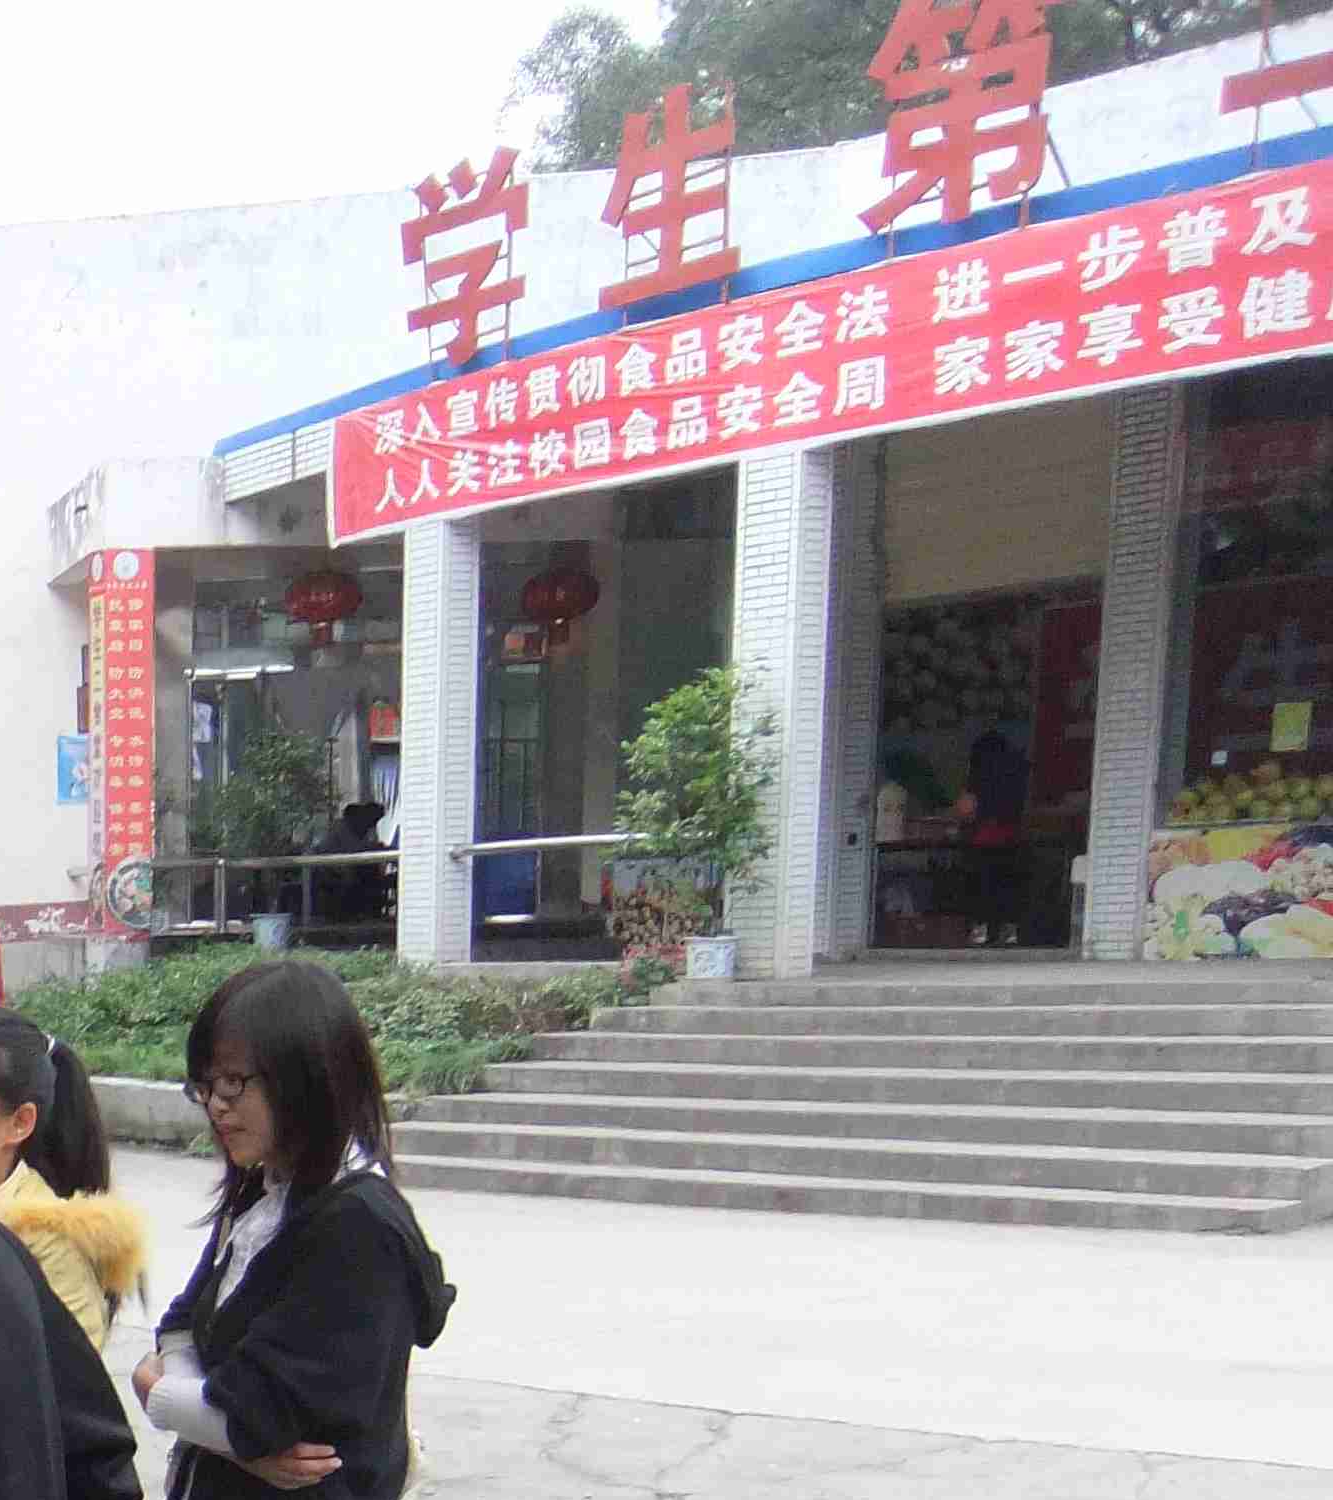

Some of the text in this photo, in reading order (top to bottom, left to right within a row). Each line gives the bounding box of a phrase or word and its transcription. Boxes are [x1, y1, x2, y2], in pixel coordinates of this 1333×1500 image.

[374, 186, 1318, 457] 深入宣传贯彻食品安全法 进一步普及
[374, 268, 1333, 513] 人人关注校园食品安全周 家家享受健
